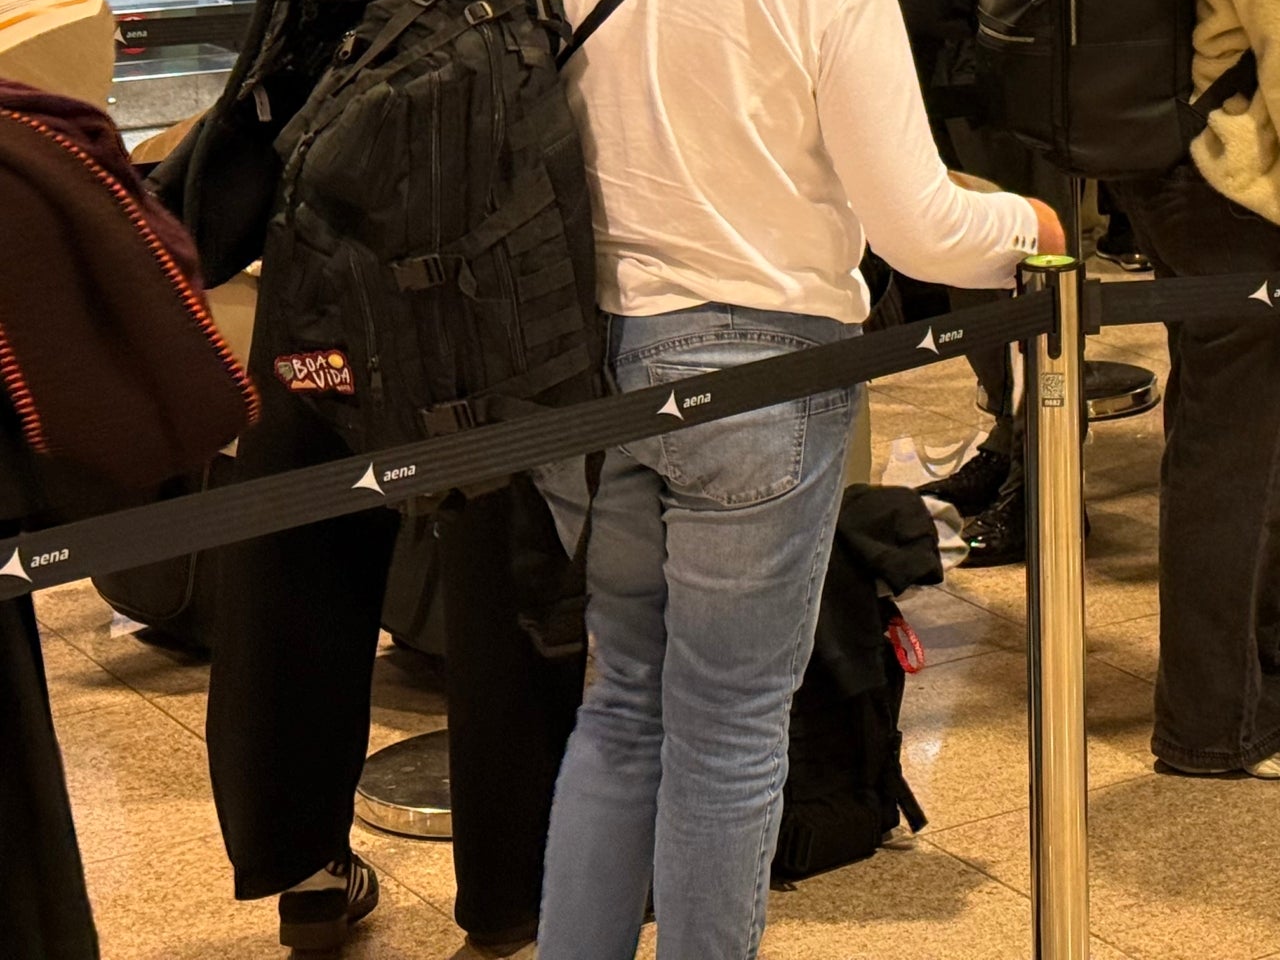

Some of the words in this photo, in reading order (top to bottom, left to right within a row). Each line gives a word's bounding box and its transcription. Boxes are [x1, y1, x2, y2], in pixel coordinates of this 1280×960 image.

[126, 29, 148, 39] aena
[938, 328, 964, 344] aena
[292, 355, 328, 380] BOA
[683, 392, 712, 409] aena
[383, 464, 416, 482] aena
[30, 548, 70, 569] aena
